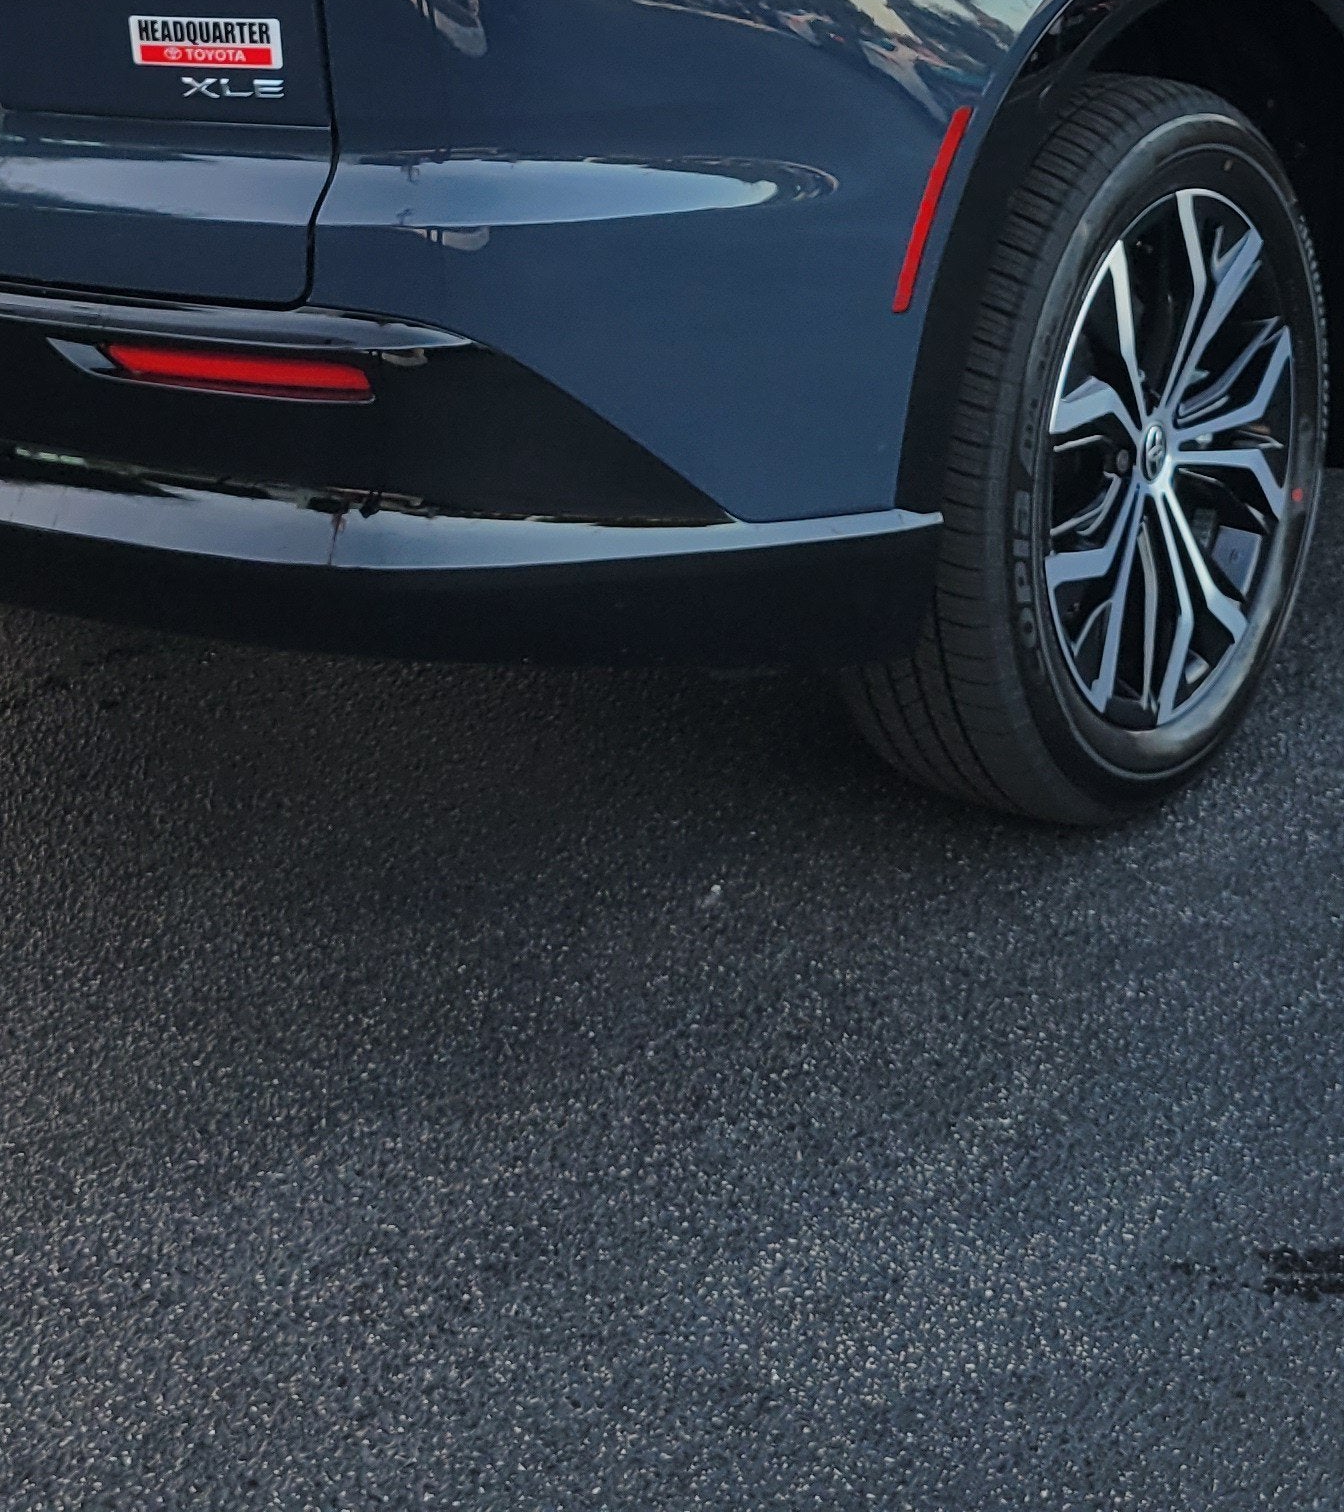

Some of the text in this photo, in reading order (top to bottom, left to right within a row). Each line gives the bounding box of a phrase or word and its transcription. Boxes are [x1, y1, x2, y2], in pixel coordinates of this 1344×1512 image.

[138, 19, 271, 45] HEADQUARTER
[185, 48, 246, 62] TOYOTA
[181, 76, 285, 99] XLE
